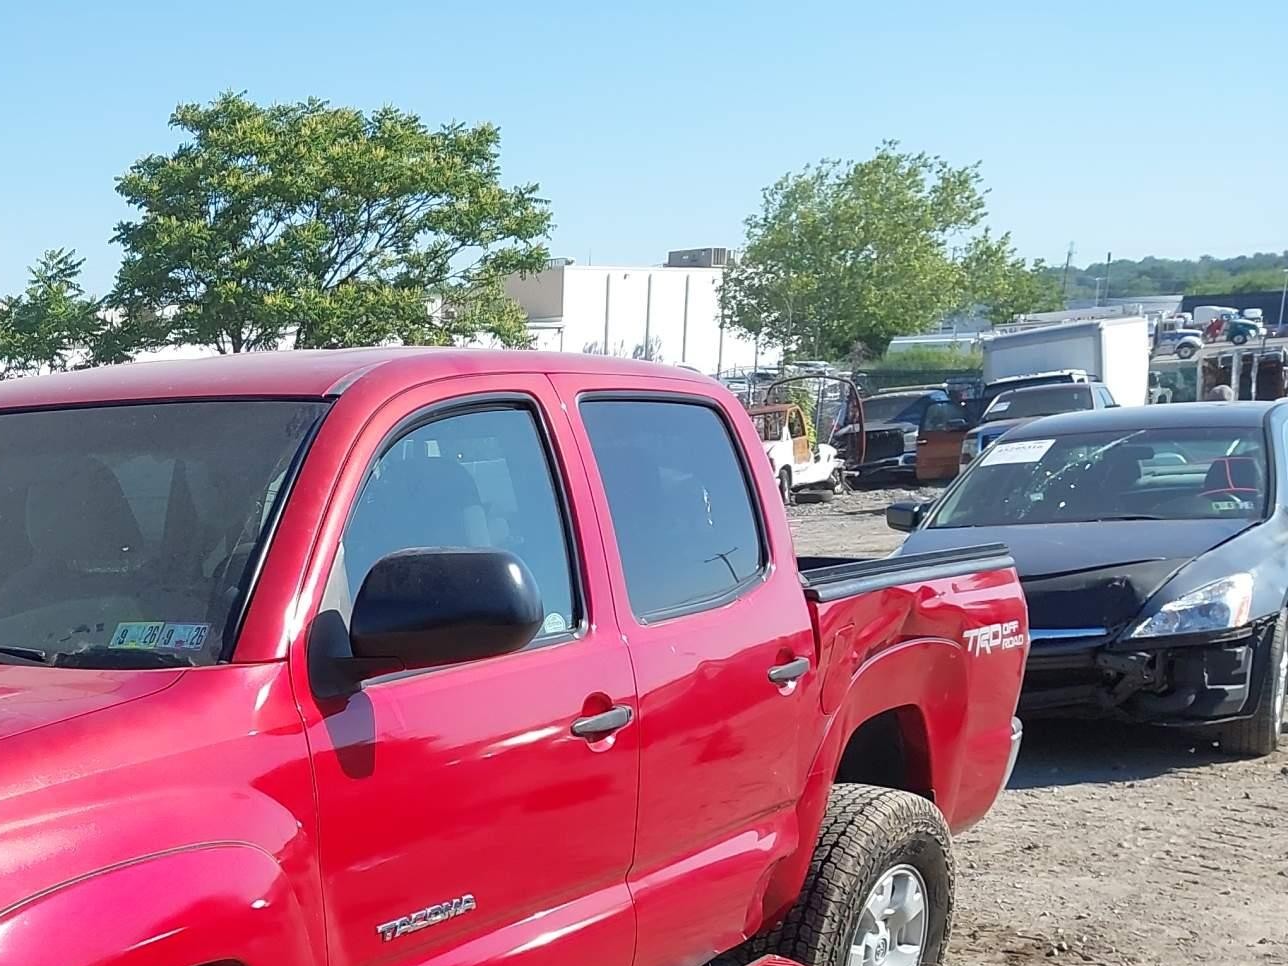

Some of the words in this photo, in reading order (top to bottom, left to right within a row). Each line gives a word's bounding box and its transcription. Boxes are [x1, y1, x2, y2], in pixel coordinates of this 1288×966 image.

[143, 625, 160, 644] 26
[190, 626, 207, 646] 26
[1002, 620, 1019, 635] OFF
[962, 623, 1002, 658] TRD
[1002, 634, 1024, 650] ROAD
[376, 893, 476, 942] TACOMA
